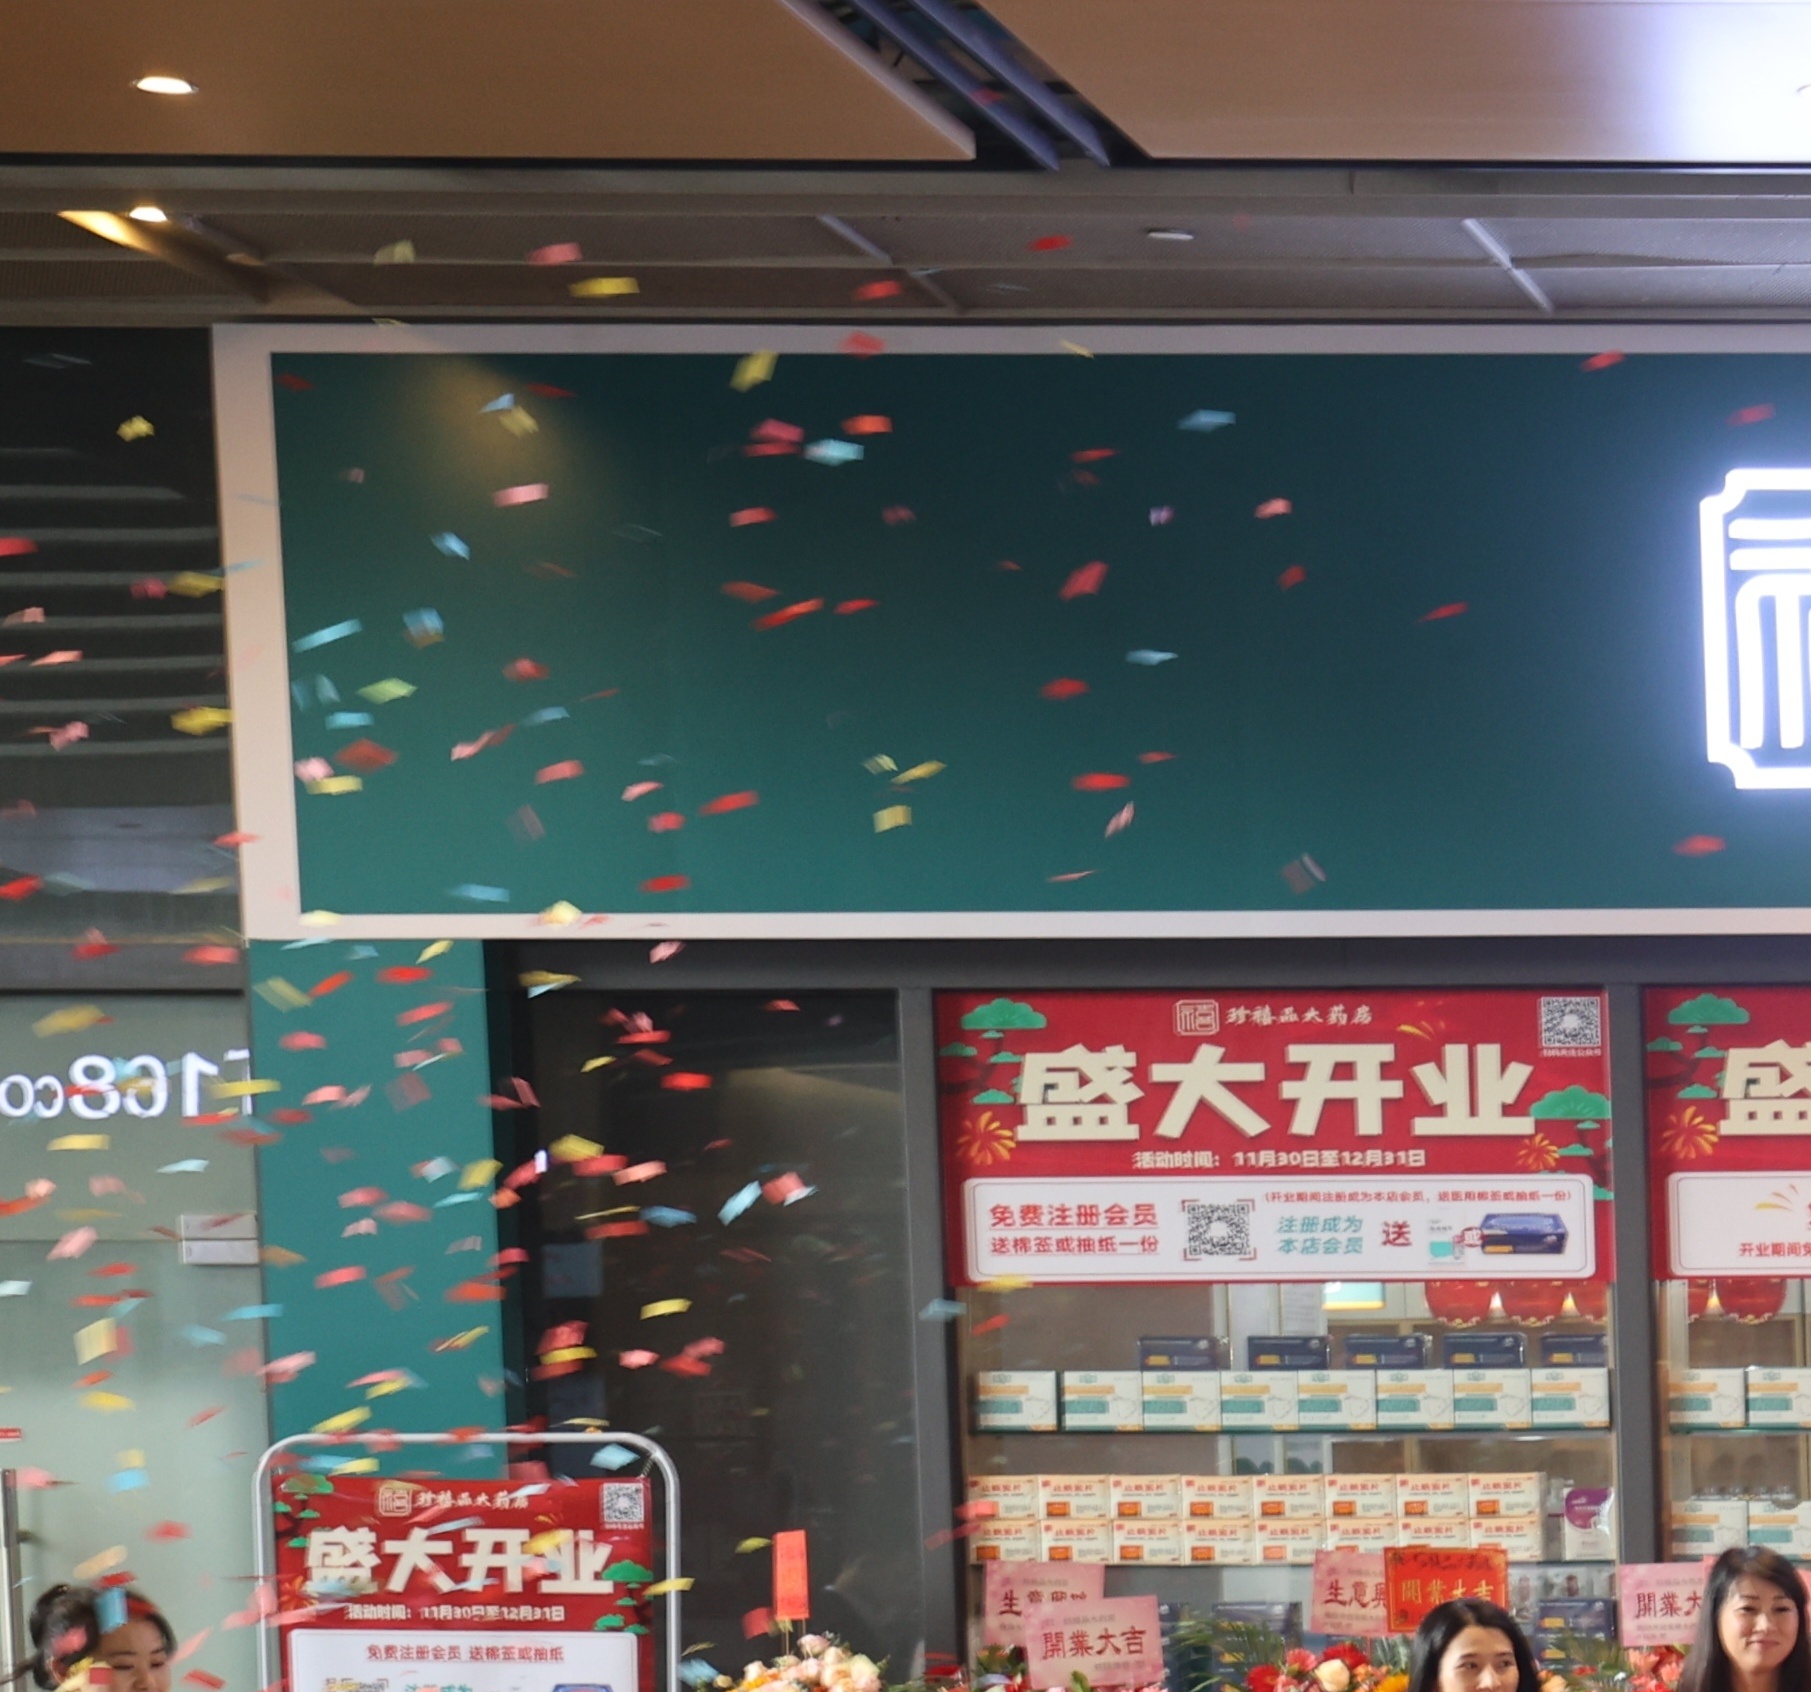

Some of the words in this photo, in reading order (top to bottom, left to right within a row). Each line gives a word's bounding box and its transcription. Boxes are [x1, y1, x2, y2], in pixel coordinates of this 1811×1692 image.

[1225, 1003, 1373, 1026] 珍禧品大药房
[1014, 1042, 1537, 1142] 盛大开业
[989, 1203, 1159, 1228] 免费注册会员
[1276, 1215, 1364, 1234] 注册成为
[1278, 1236, 1364, 1255] 本店会员
[1381, 1220, 1413, 1247] 送
[305, 1525, 615, 1596] 盛大开业
[367, 1644, 462, 1662] 免费注册会员
[1041, 1625, 1147, 1661] 開業大吉
